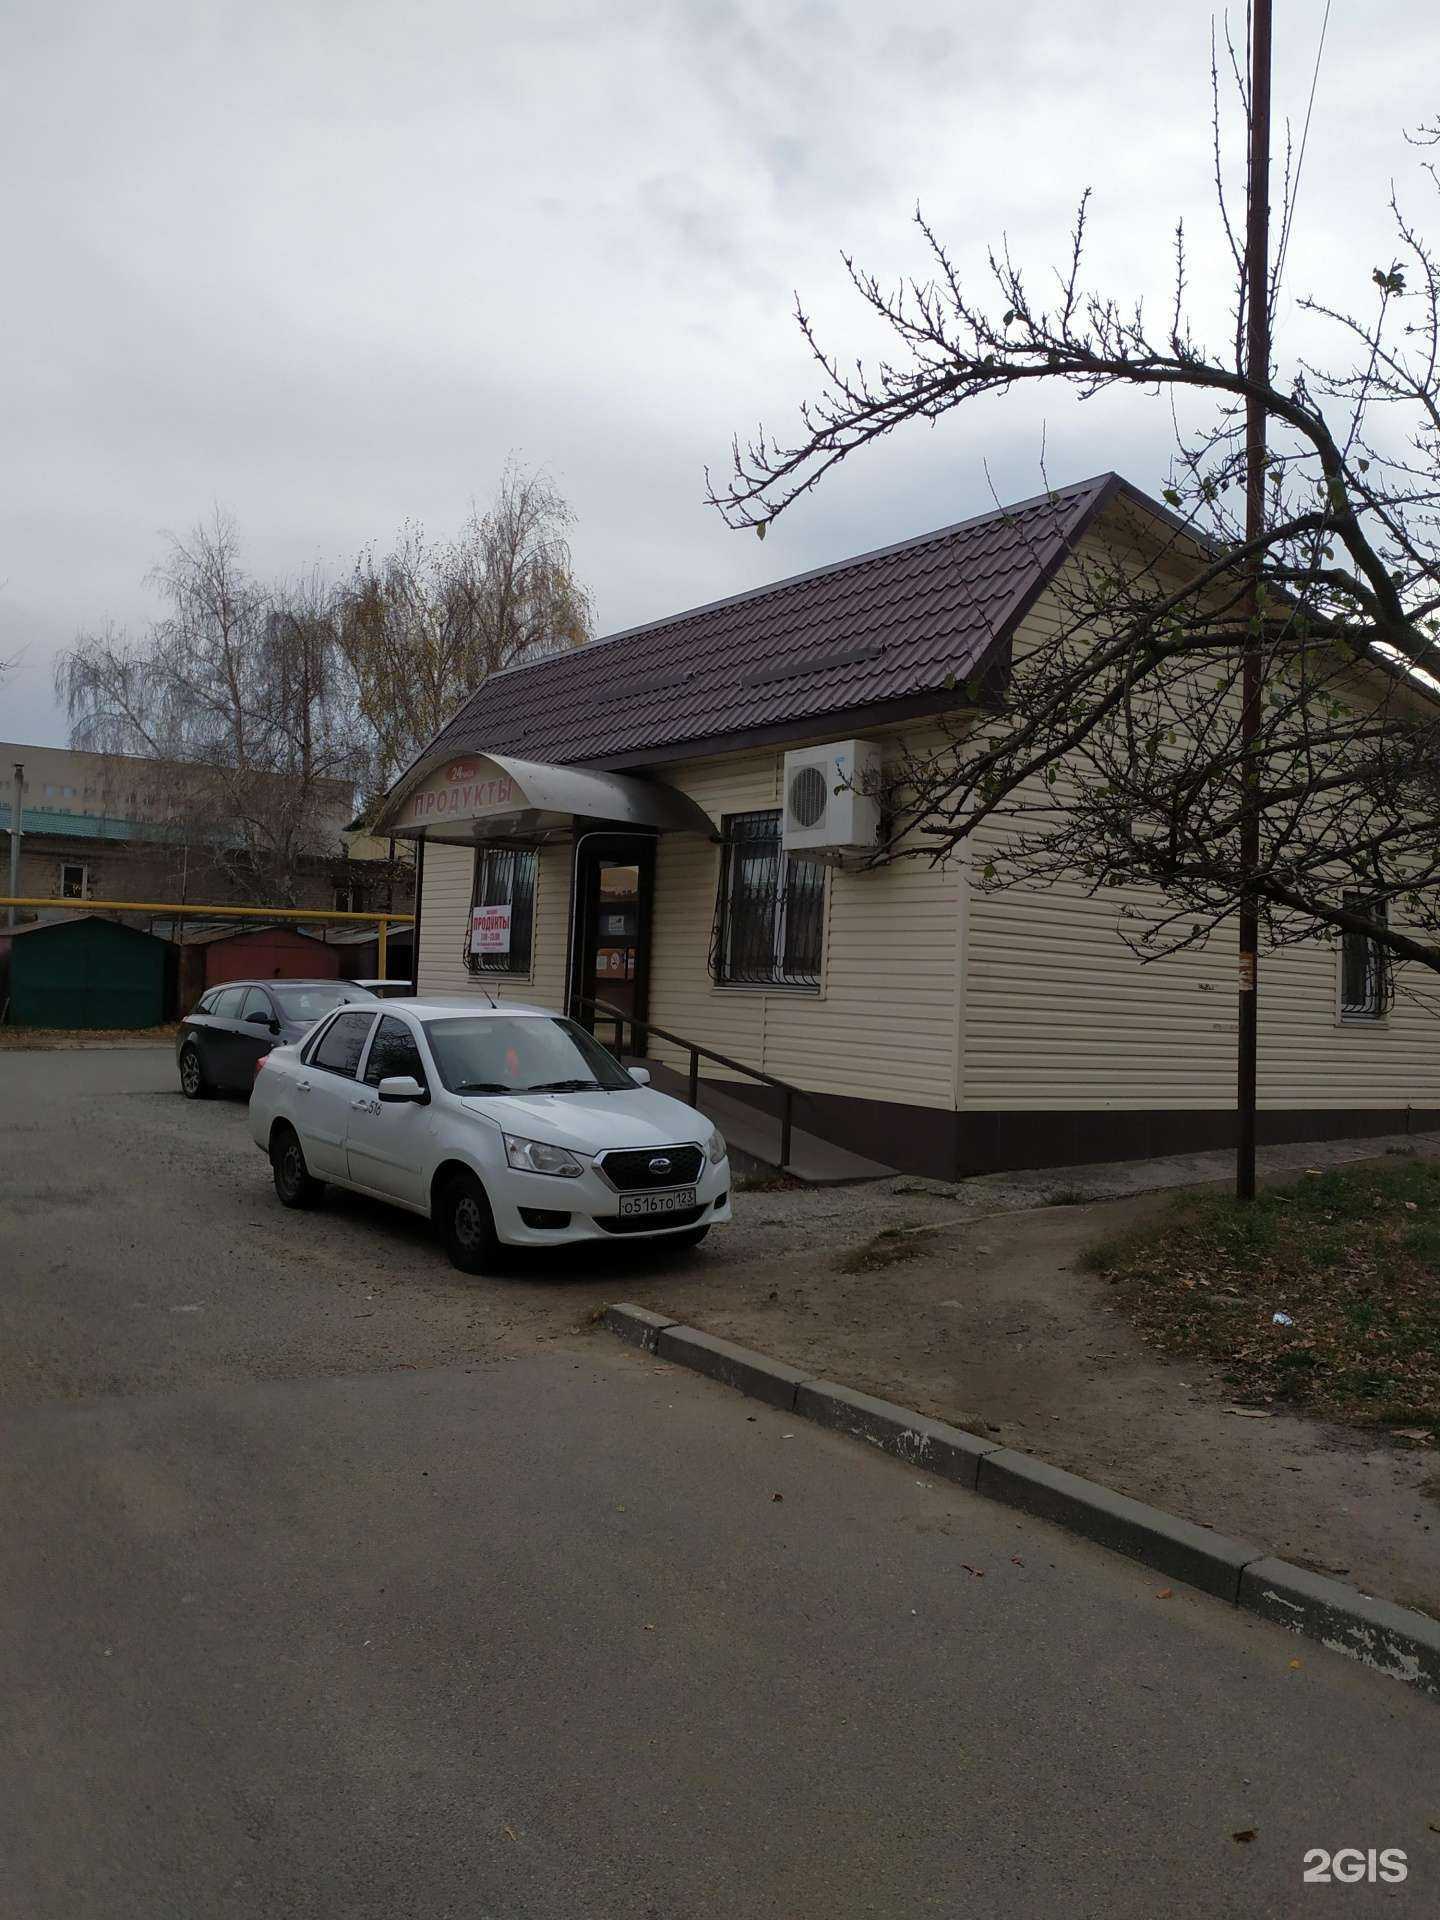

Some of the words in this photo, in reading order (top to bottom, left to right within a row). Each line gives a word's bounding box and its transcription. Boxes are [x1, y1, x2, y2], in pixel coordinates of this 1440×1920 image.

[413, 777, 513, 817] ПРОДУКТЫ
[473, 916, 510, 931] ПРОДУКТЫ
[368, 1100, 382, 1116] 516
[676, 1191, 694, 1204] 123
